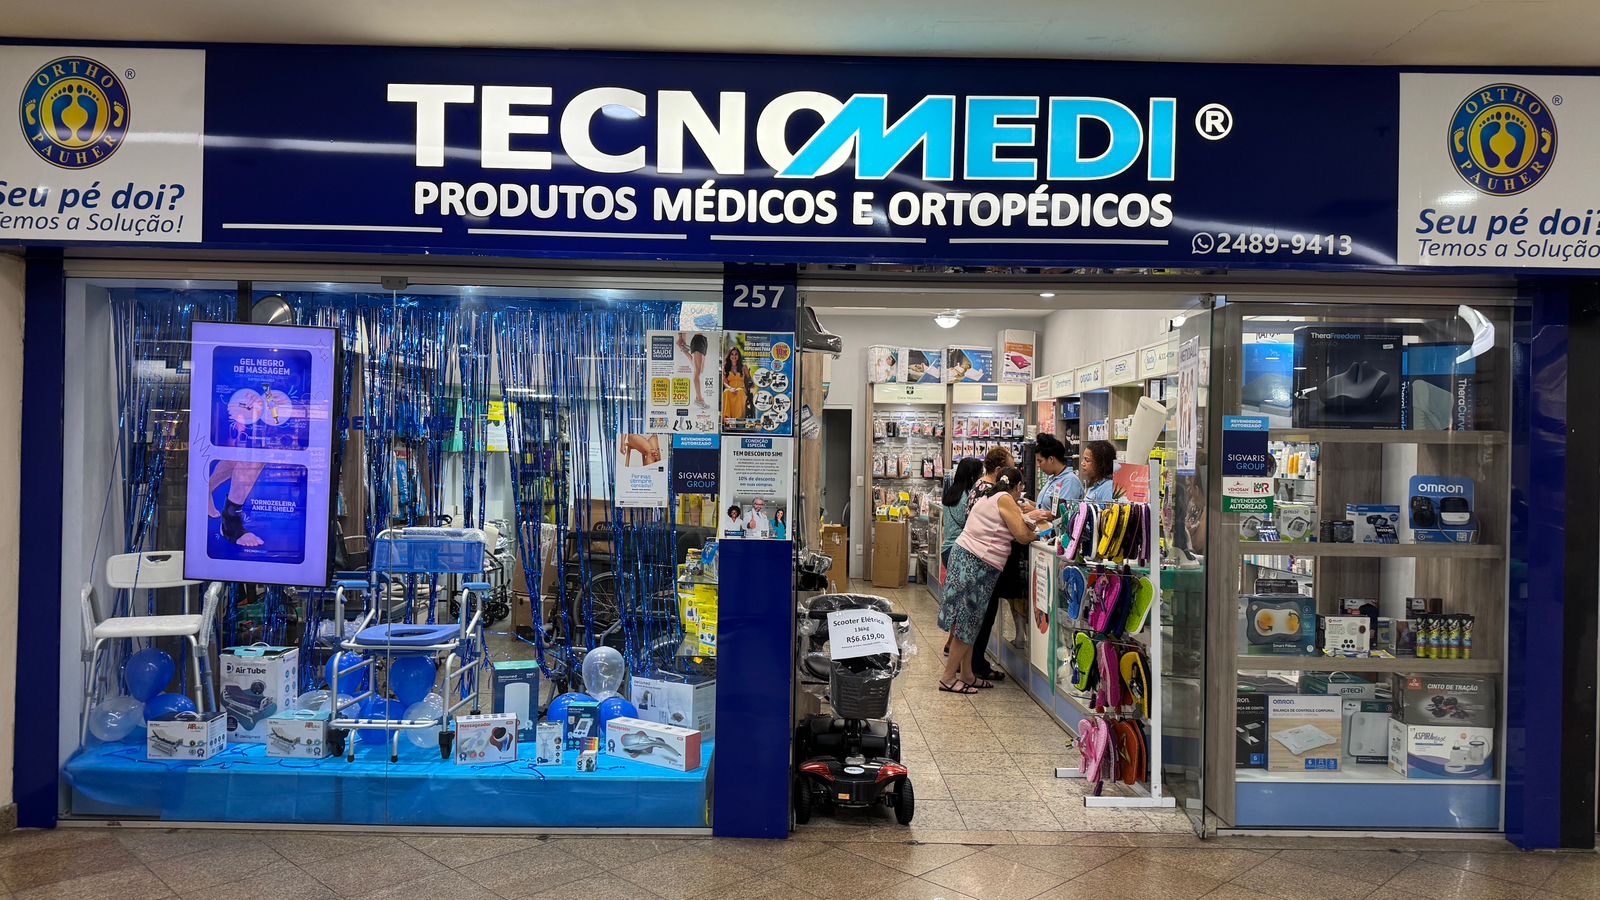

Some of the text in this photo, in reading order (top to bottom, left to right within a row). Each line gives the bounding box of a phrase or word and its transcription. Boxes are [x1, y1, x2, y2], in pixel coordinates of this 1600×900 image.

[37, 61, 114, 88] ORTHO
[1465, 88, 1541, 114] ORTHO
[387, 84, 1176, 181] TECNOMEDI
[32, 132, 117, 164] PAUHER
[1460, 160, 1545, 191] PAUHER
[57, 181, 101, 214] pé
[111, 182, 185, 210] doi?
[415, 180, 1174, 228] PRODUTOS MÉDICOS E ORTOPÉDICOS
[0, 211, 184, 236] emos a Solução!
[1415, 207, 1600, 241] Seu pé doi
[1217, 233, 1353, 256] 2489-9413
[1418, 238, 1488, 257] Temos
[1494, 243, 1508, 257] a
[732, 284, 785, 309] 257
[1311, 332, 1361, 340] TheraFreedom
[240, 357, 285, 367] GEL NEGRO
[233, 365, 290, 375] DE MASSAGEM
[1227, 454, 1265, 462] SIGVARIS
[1235, 462, 1265, 470] GROUP
[678, 471, 716, 480] SIGVARIS
[686, 480, 716, 488] GROUP
[251, 498, 296, 507] TORNOZELEIRA
[833, 616, 885, 627] Scooter Elétrica
[846, 632, 885, 643] R$6.619,00
[235, 666, 267, 674] Air Tube
[1455, 684, 1479, 692] TRAÇÃO
